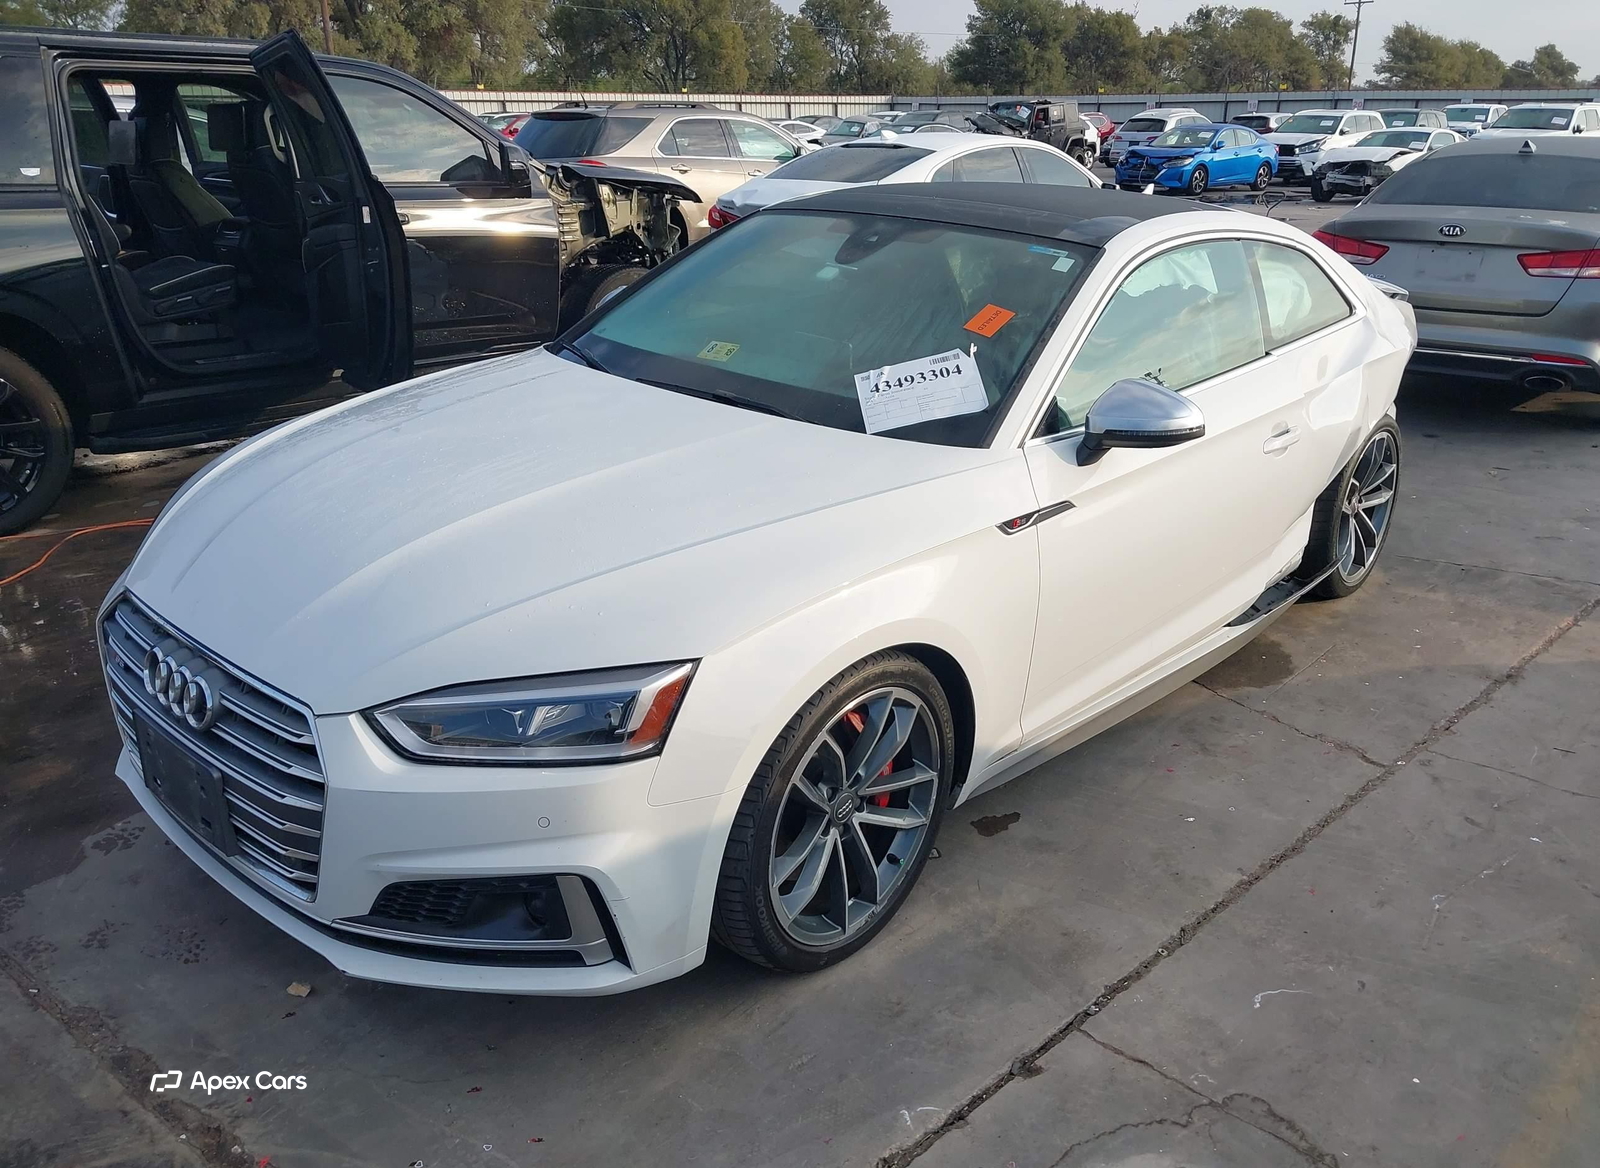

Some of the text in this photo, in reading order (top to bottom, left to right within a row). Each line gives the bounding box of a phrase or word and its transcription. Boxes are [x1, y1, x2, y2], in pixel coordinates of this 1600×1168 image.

[1353, 101, 1363, 109] 20
[1442, 226, 1461, 235] KIA
[978, 310, 1002, 331] DETAILED
[870, 364, 963, 393] 43493304
